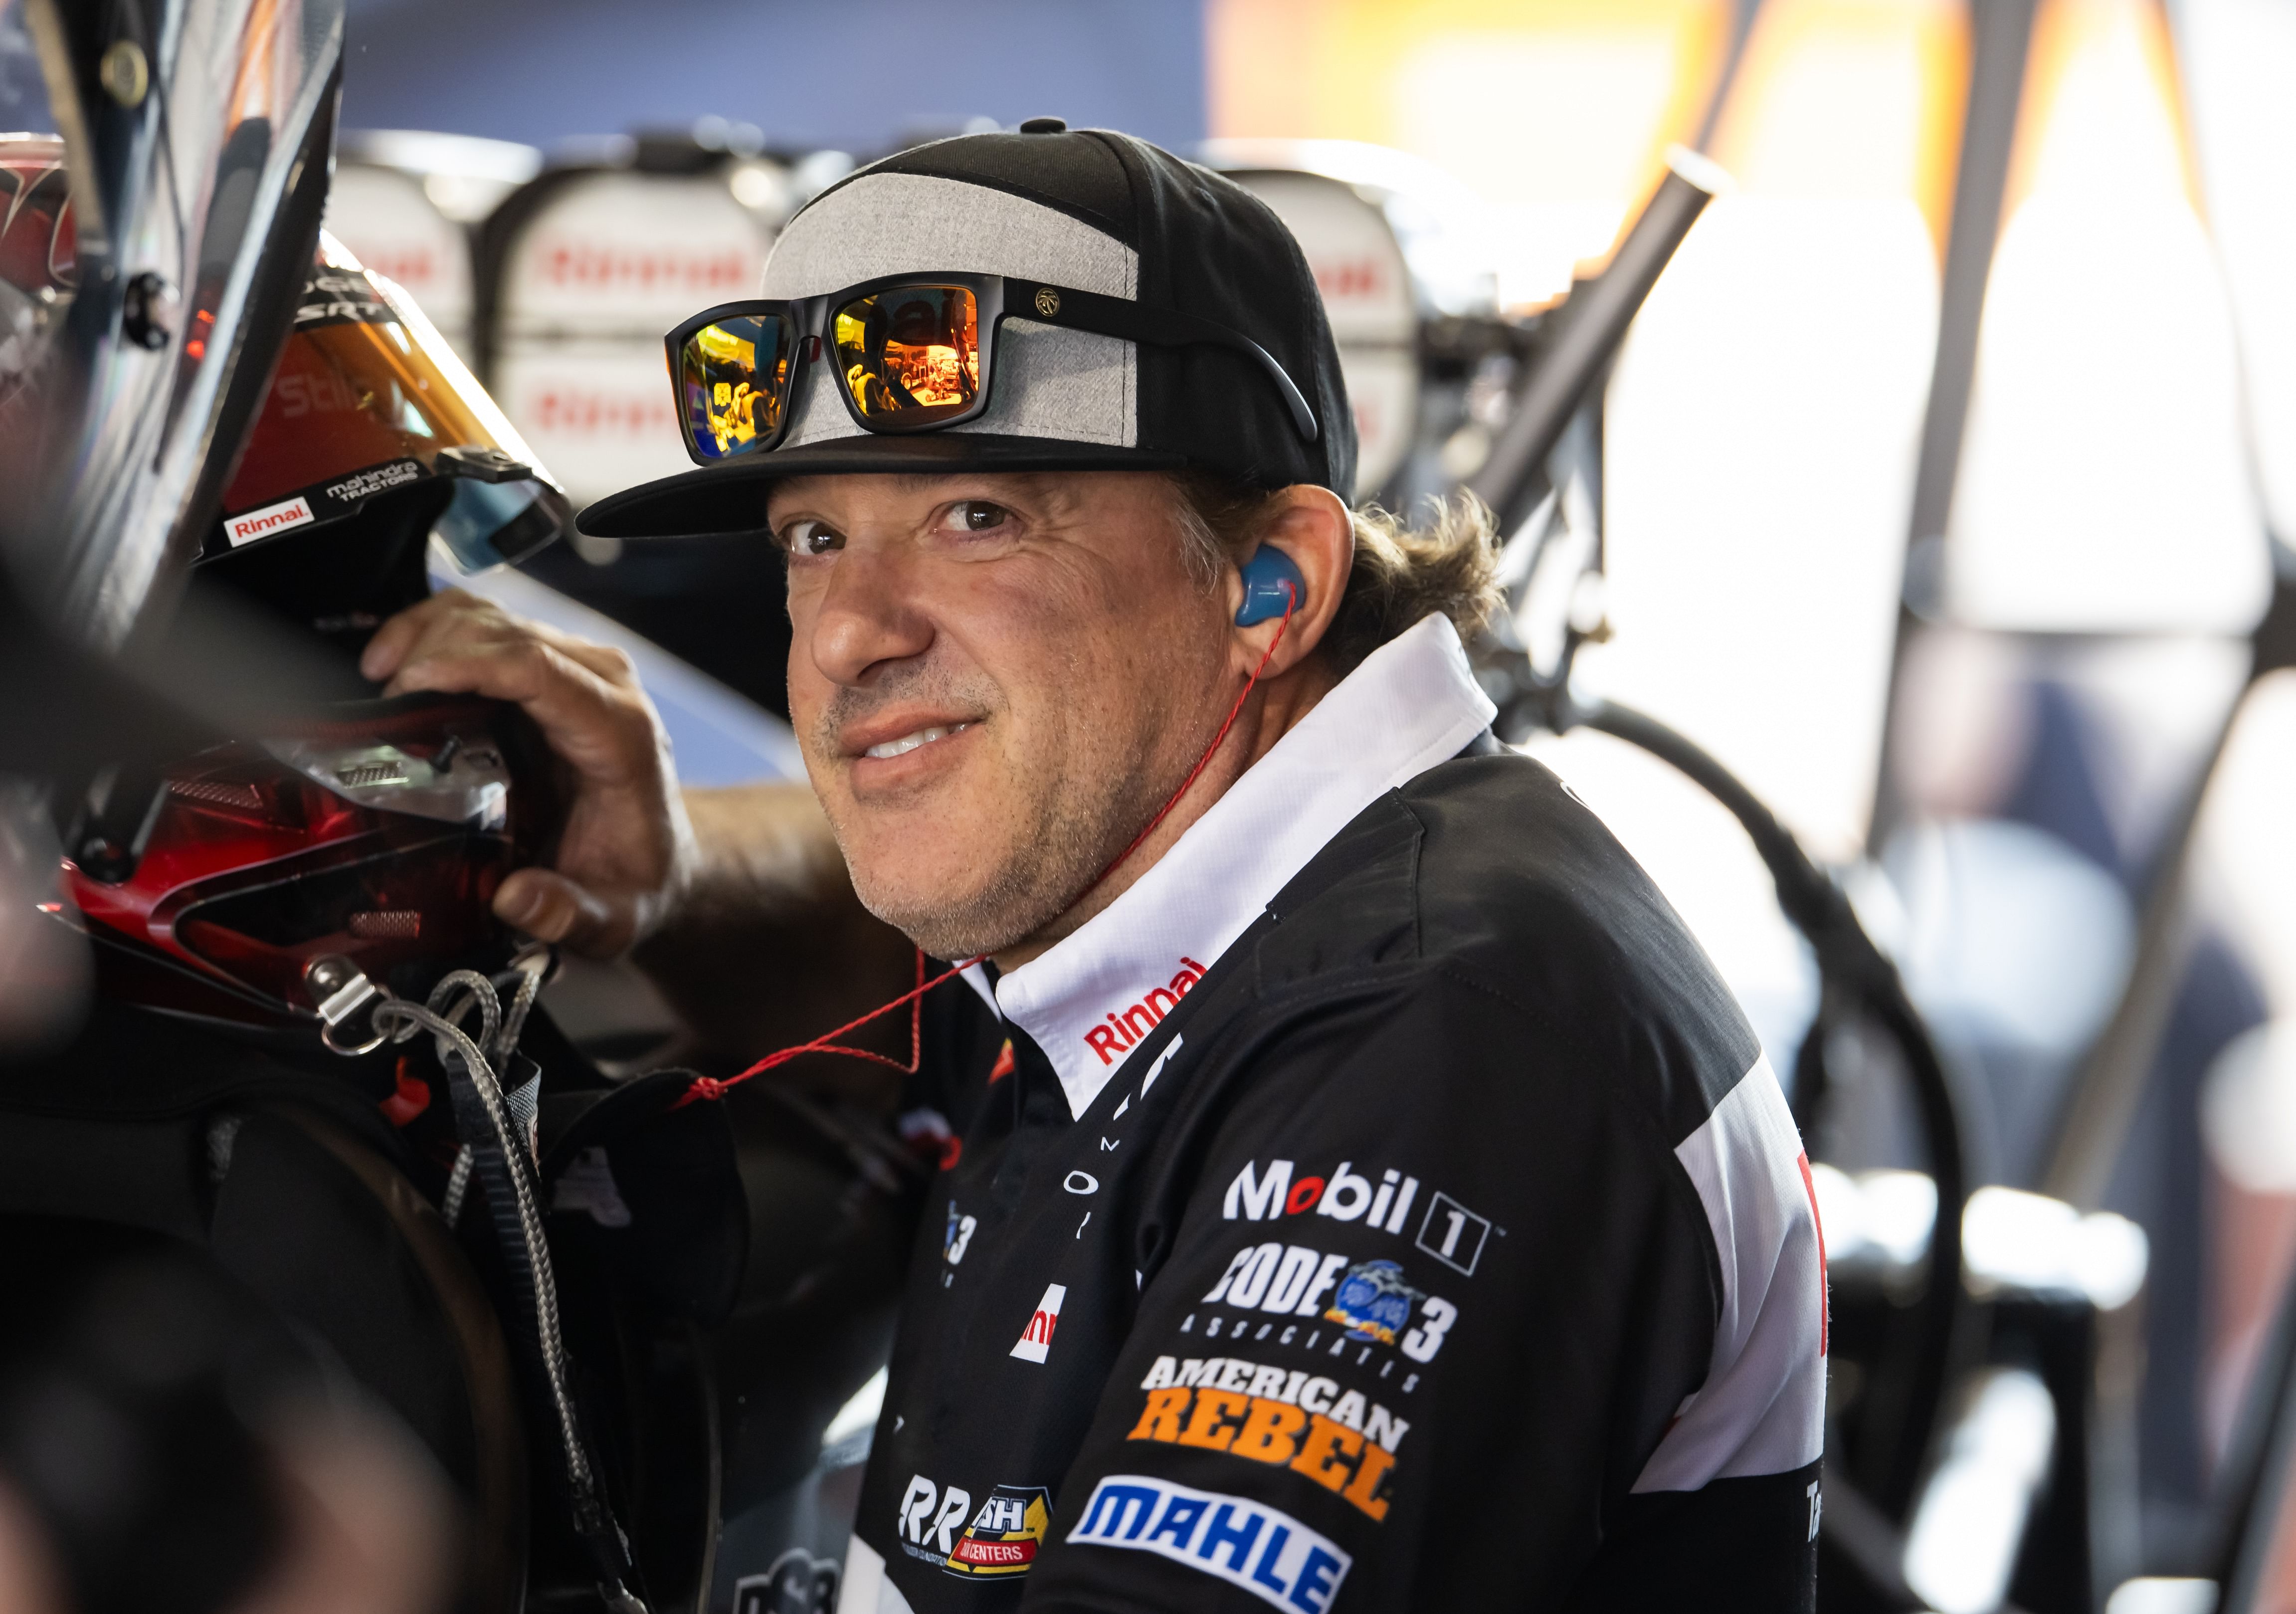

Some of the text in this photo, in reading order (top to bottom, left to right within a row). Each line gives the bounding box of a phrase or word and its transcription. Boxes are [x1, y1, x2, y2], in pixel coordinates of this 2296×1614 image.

[325, 461, 418, 499] mahindra
[340, 472, 419, 502] TRACTORS
[1083, 956, 1208, 1067] Rinnai
[1222, 1159, 1466, 1258] Mobil 1
[1201, 1242, 1349, 1317] CODE
[1401, 1295, 1458, 1364] 3
[1179, 1313, 1421, 1394] ASSOCIATES
[1141, 1355, 1411, 1453] AMERICAN
[1126, 1386, 1399, 1524] REBEL
[969, 1543, 1023, 1561] CENTERS
[1079, 1485, 1341, 1614] MAHLE
